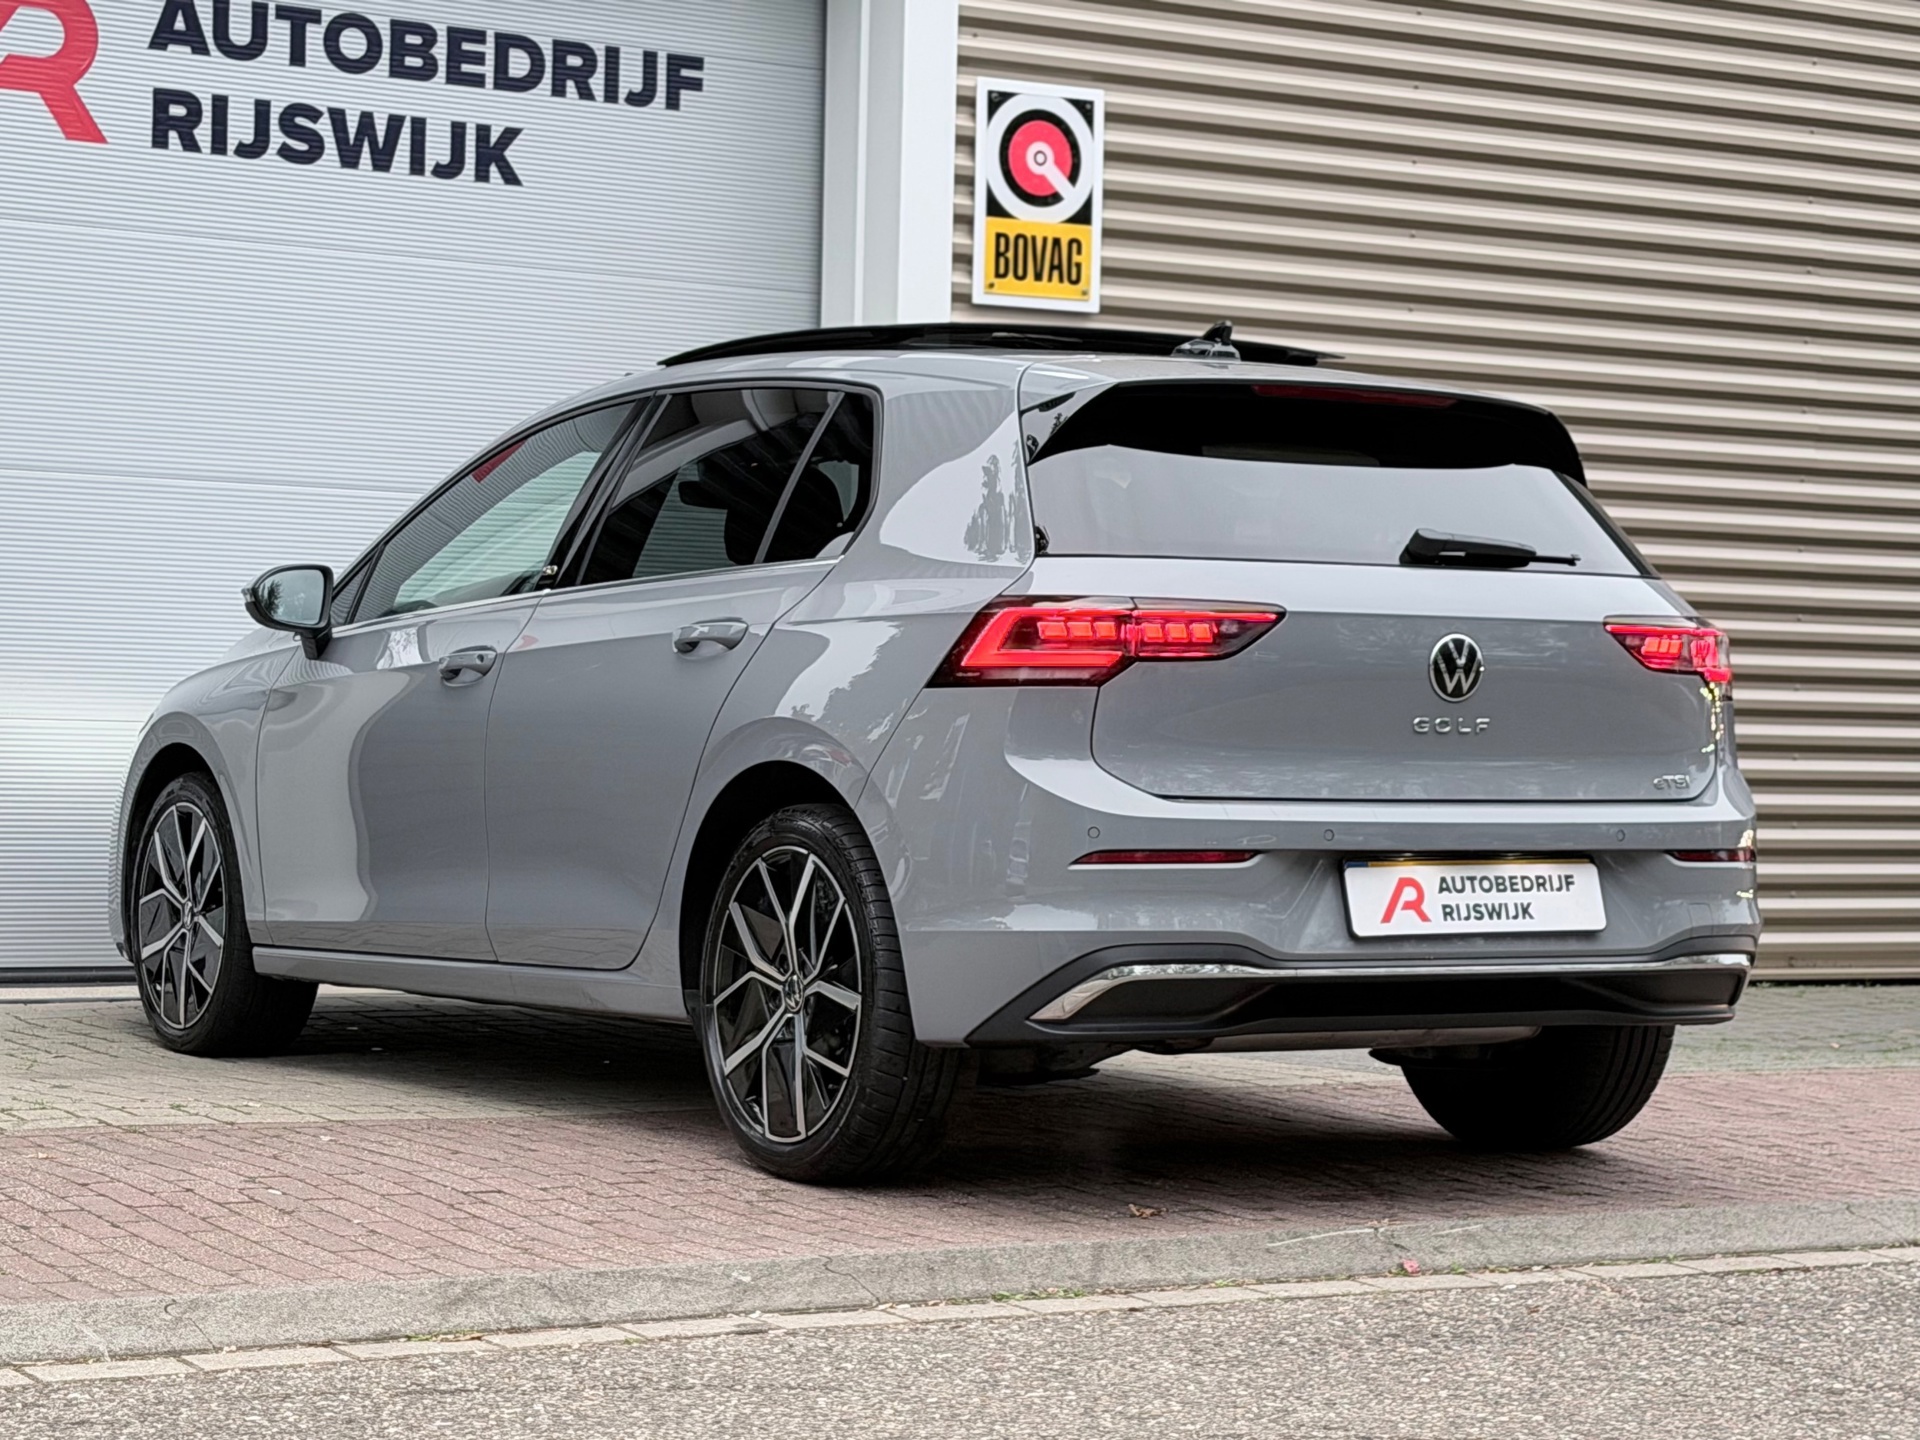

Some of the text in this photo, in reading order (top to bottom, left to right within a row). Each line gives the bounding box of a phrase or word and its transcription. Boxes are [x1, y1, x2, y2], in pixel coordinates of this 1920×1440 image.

[148, 0, 705, 111] AUTOBEDRIJF
[151, 87, 523, 187] RIJSWIJK
[993, 232, 1083, 286] BOVAG
[1413, 716, 1491, 733] GOLF
[1438, 873, 1575, 895] AUTOBEDRIJF
[1441, 902, 1535, 922] RIJSWIJK
